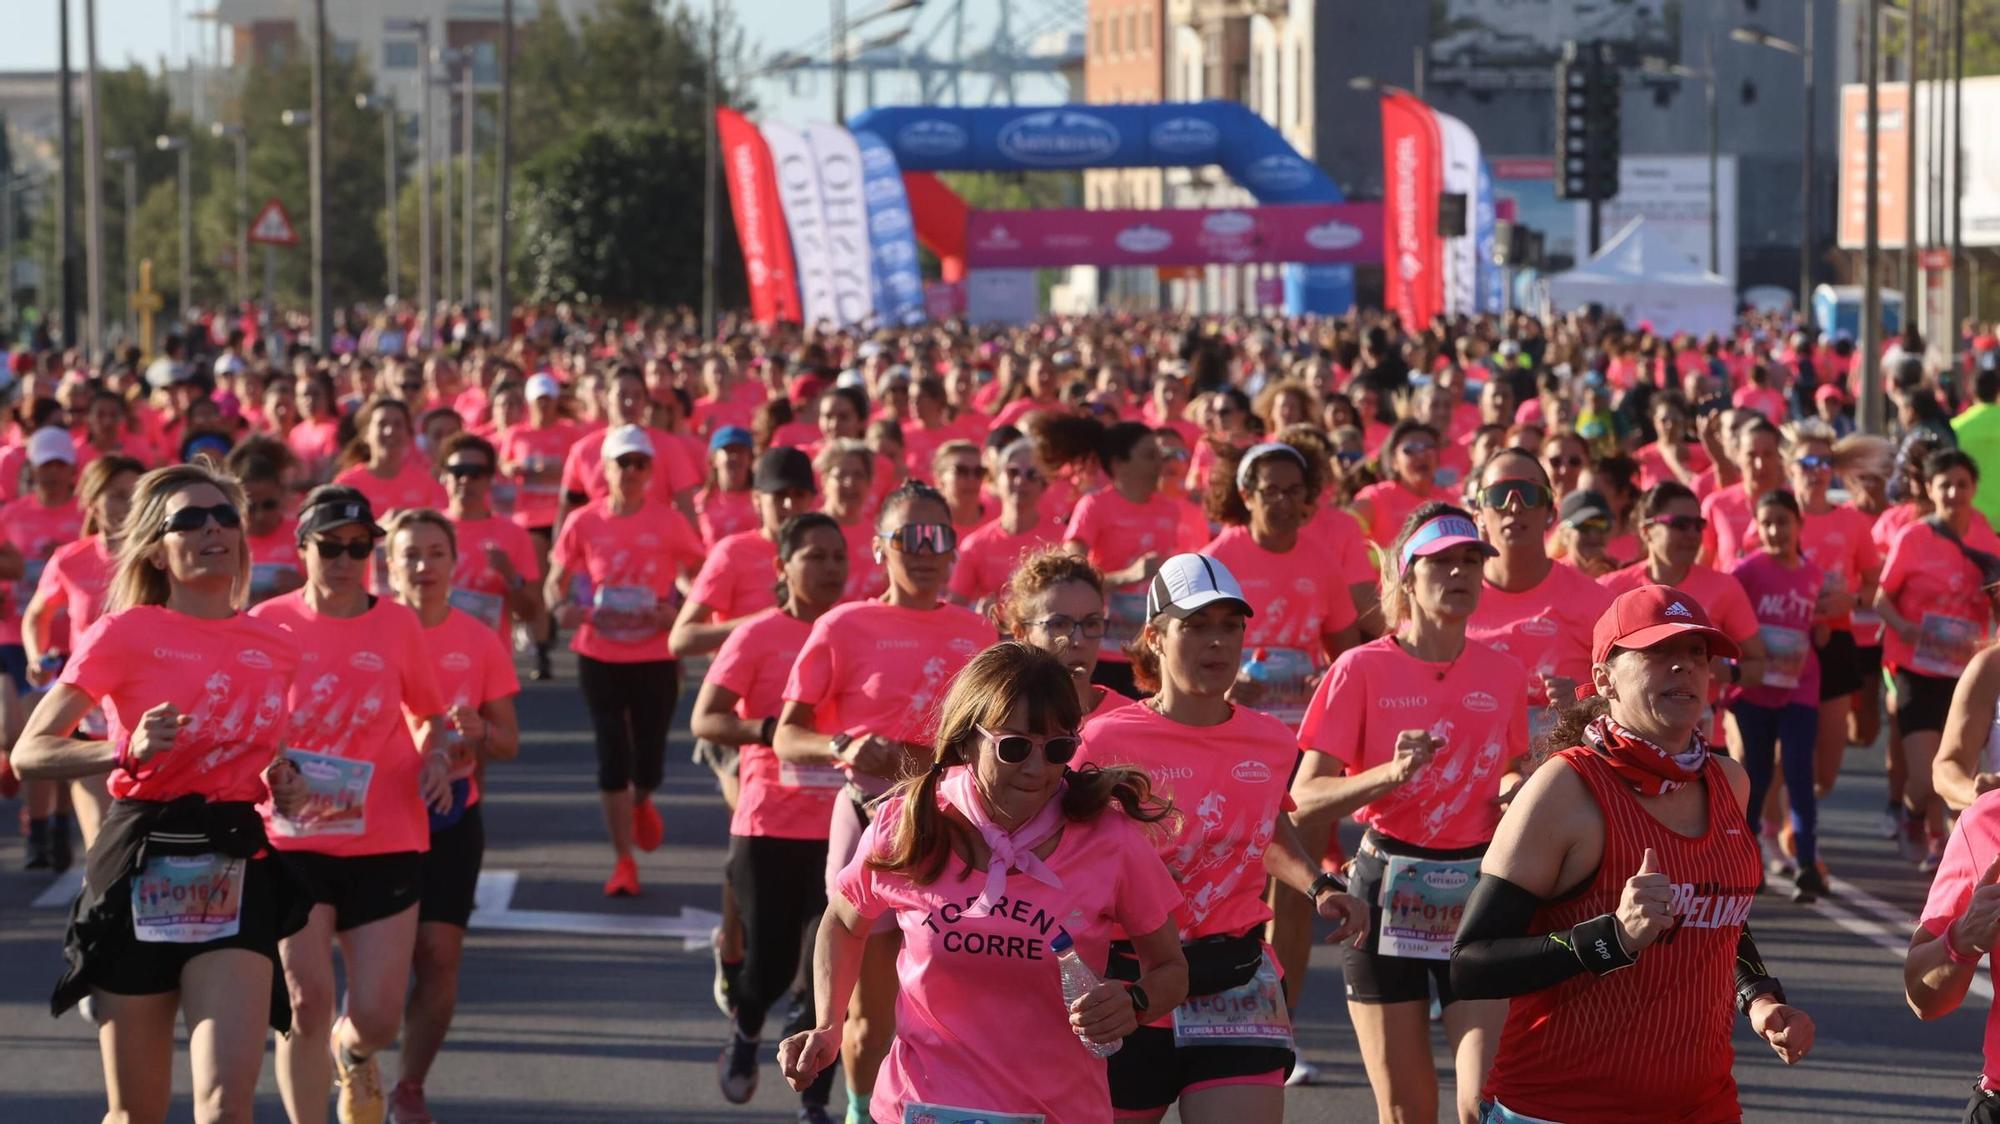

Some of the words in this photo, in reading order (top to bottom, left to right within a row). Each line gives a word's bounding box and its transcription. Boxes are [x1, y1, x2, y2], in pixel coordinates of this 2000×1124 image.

[1665, 609, 1693, 618] adidas
[1379, 695, 1428, 708] OYSHO
[943, 931, 1044, 960] CORRE
[1184, 1026, 1214, 1035] CARRERA
